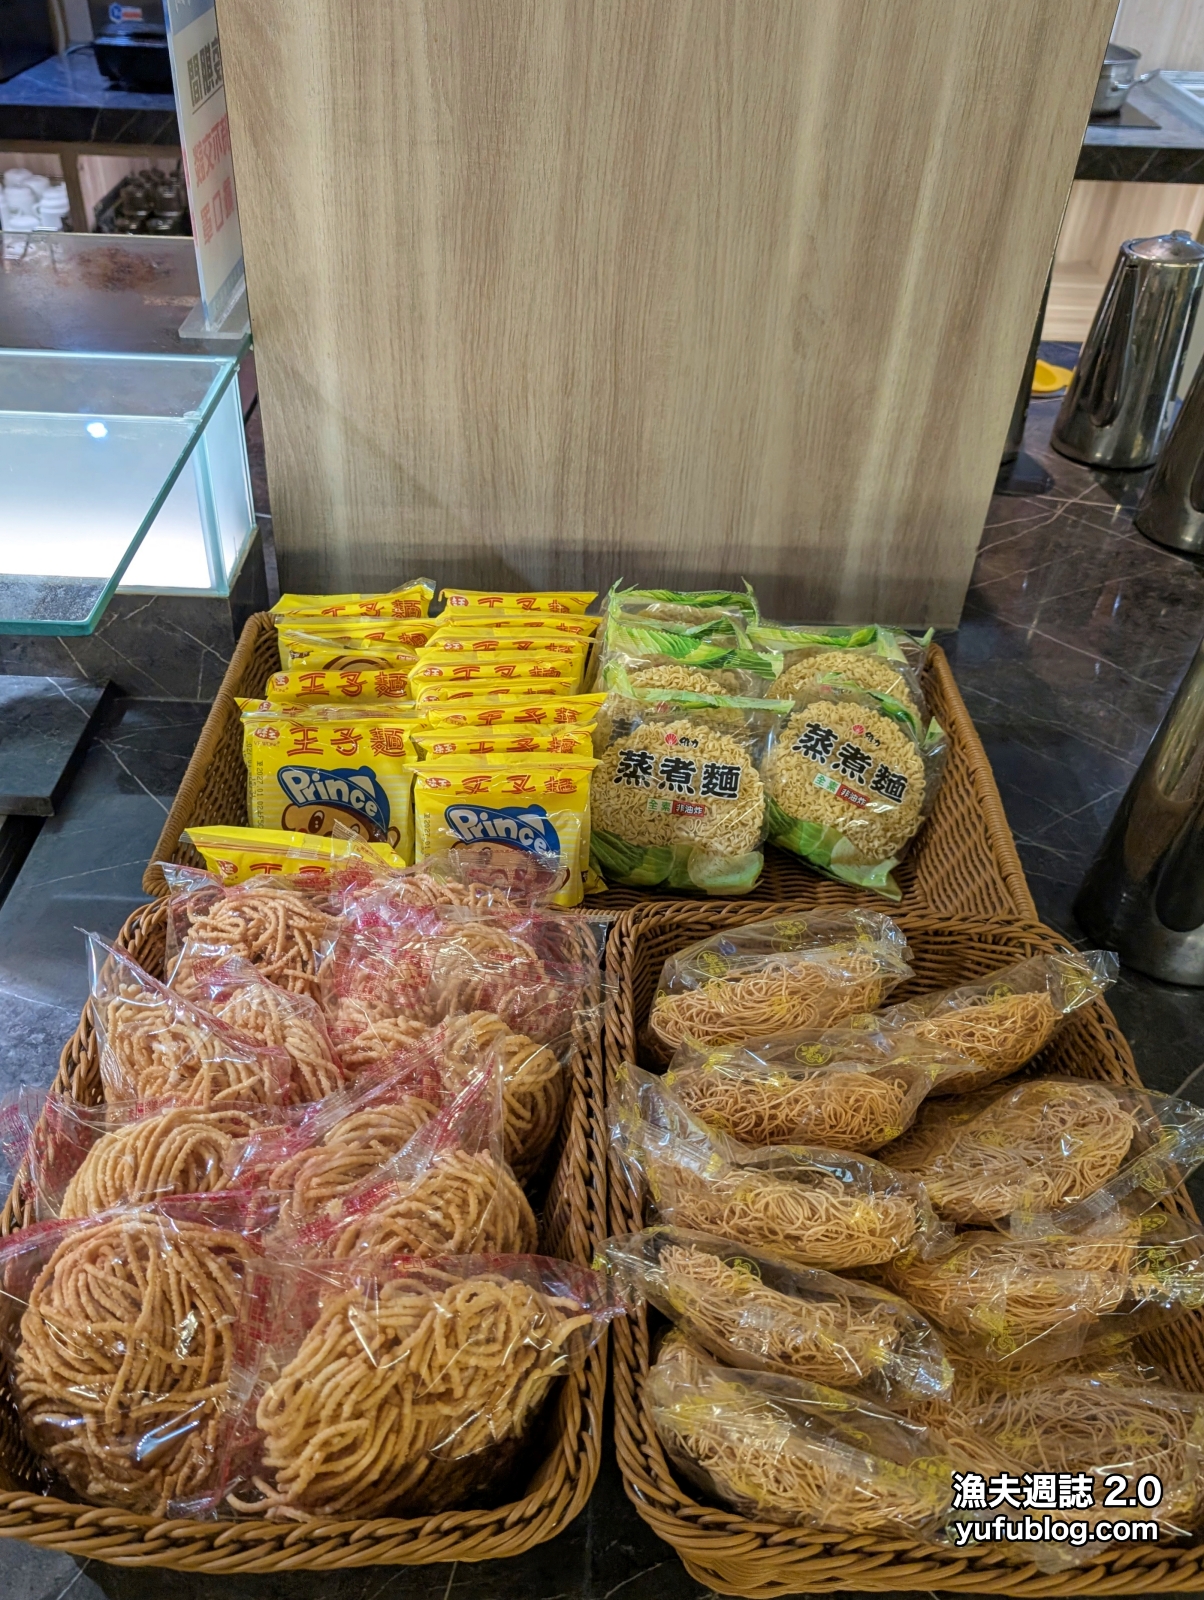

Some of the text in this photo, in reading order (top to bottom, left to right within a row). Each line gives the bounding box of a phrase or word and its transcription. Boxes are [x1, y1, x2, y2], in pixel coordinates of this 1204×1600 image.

[296, 671, 408, 698] 王子麵
[287, 726, 406, 757] 王子麵
[613, 750, 742, 799] 蒸煮麵
[792, 722, 908, 803] 蒸煮麵
[281, 770, 378, 817] Prince
[648, 800, 703, 815] 全素 非油炸
[815, 775, 867, 806] 全素 非油炸
[449, 809, 547, 853] Prince
